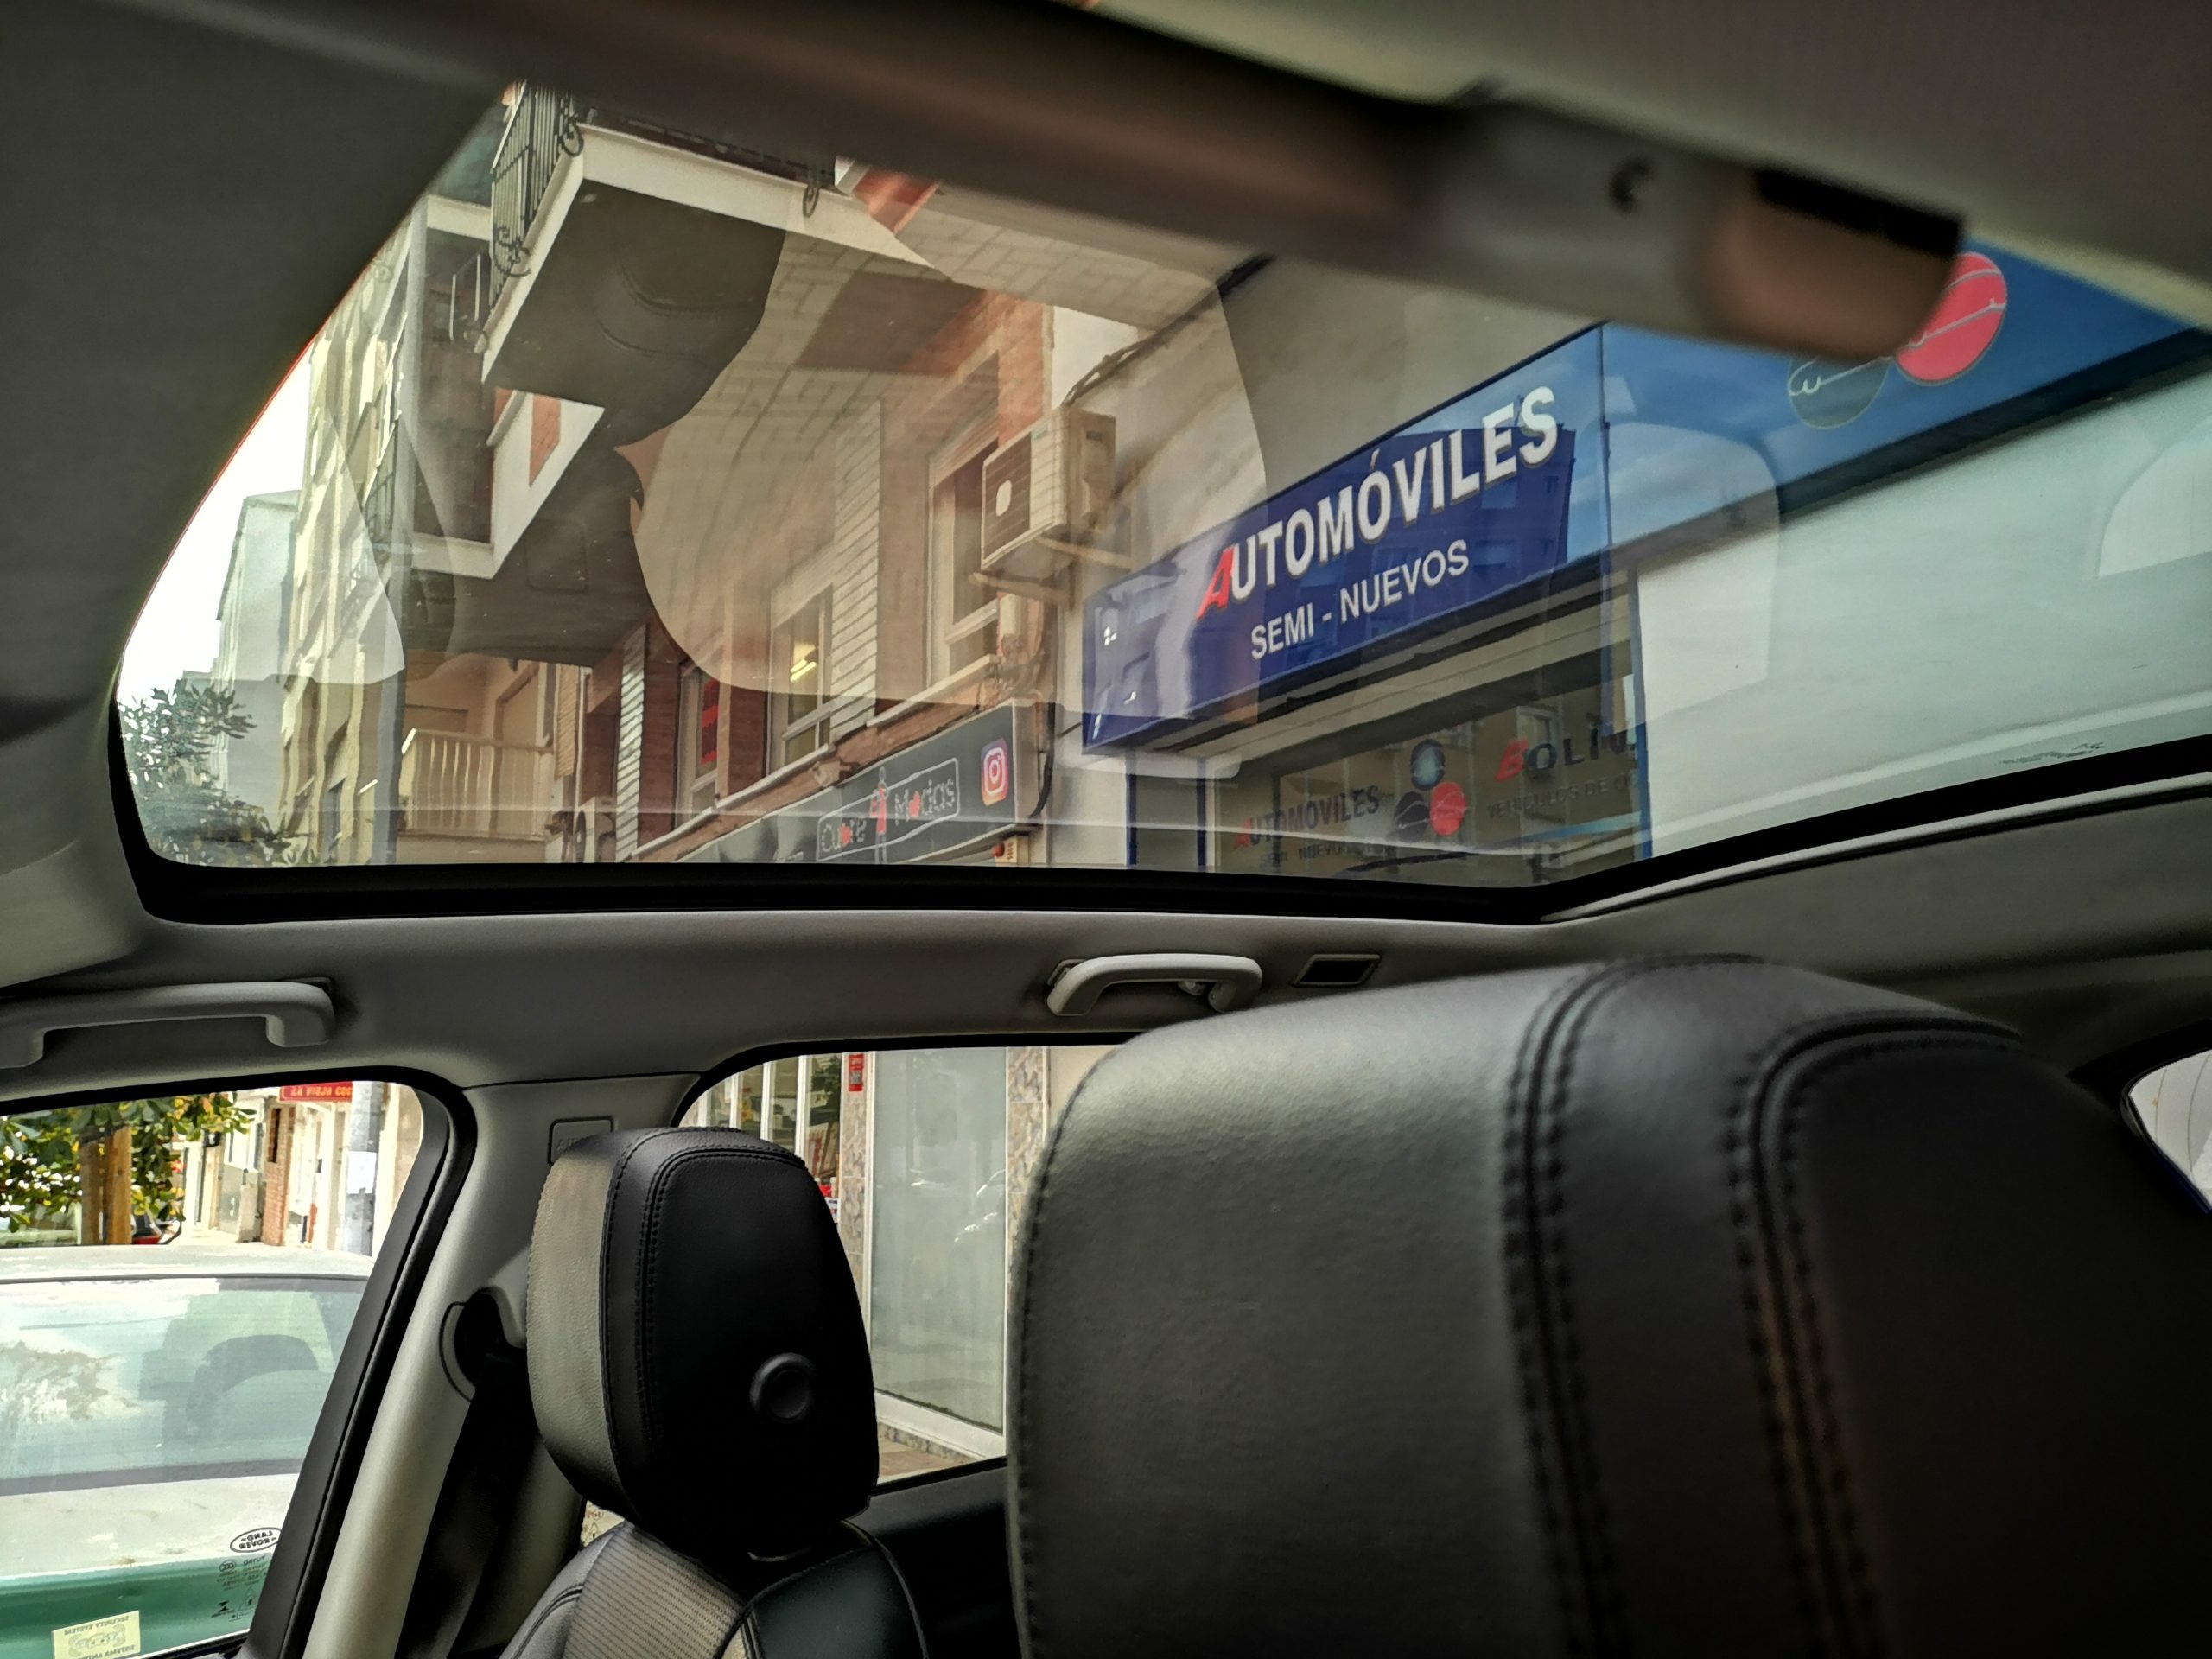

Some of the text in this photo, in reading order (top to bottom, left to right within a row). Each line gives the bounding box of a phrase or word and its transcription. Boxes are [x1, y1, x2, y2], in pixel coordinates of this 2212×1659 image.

[1196, 386, 1558, 620] AUTOMÓVILES
[1251, 610, 1315, 659] SEMI
[1338, 538, 1470, 624] NUEVOS
